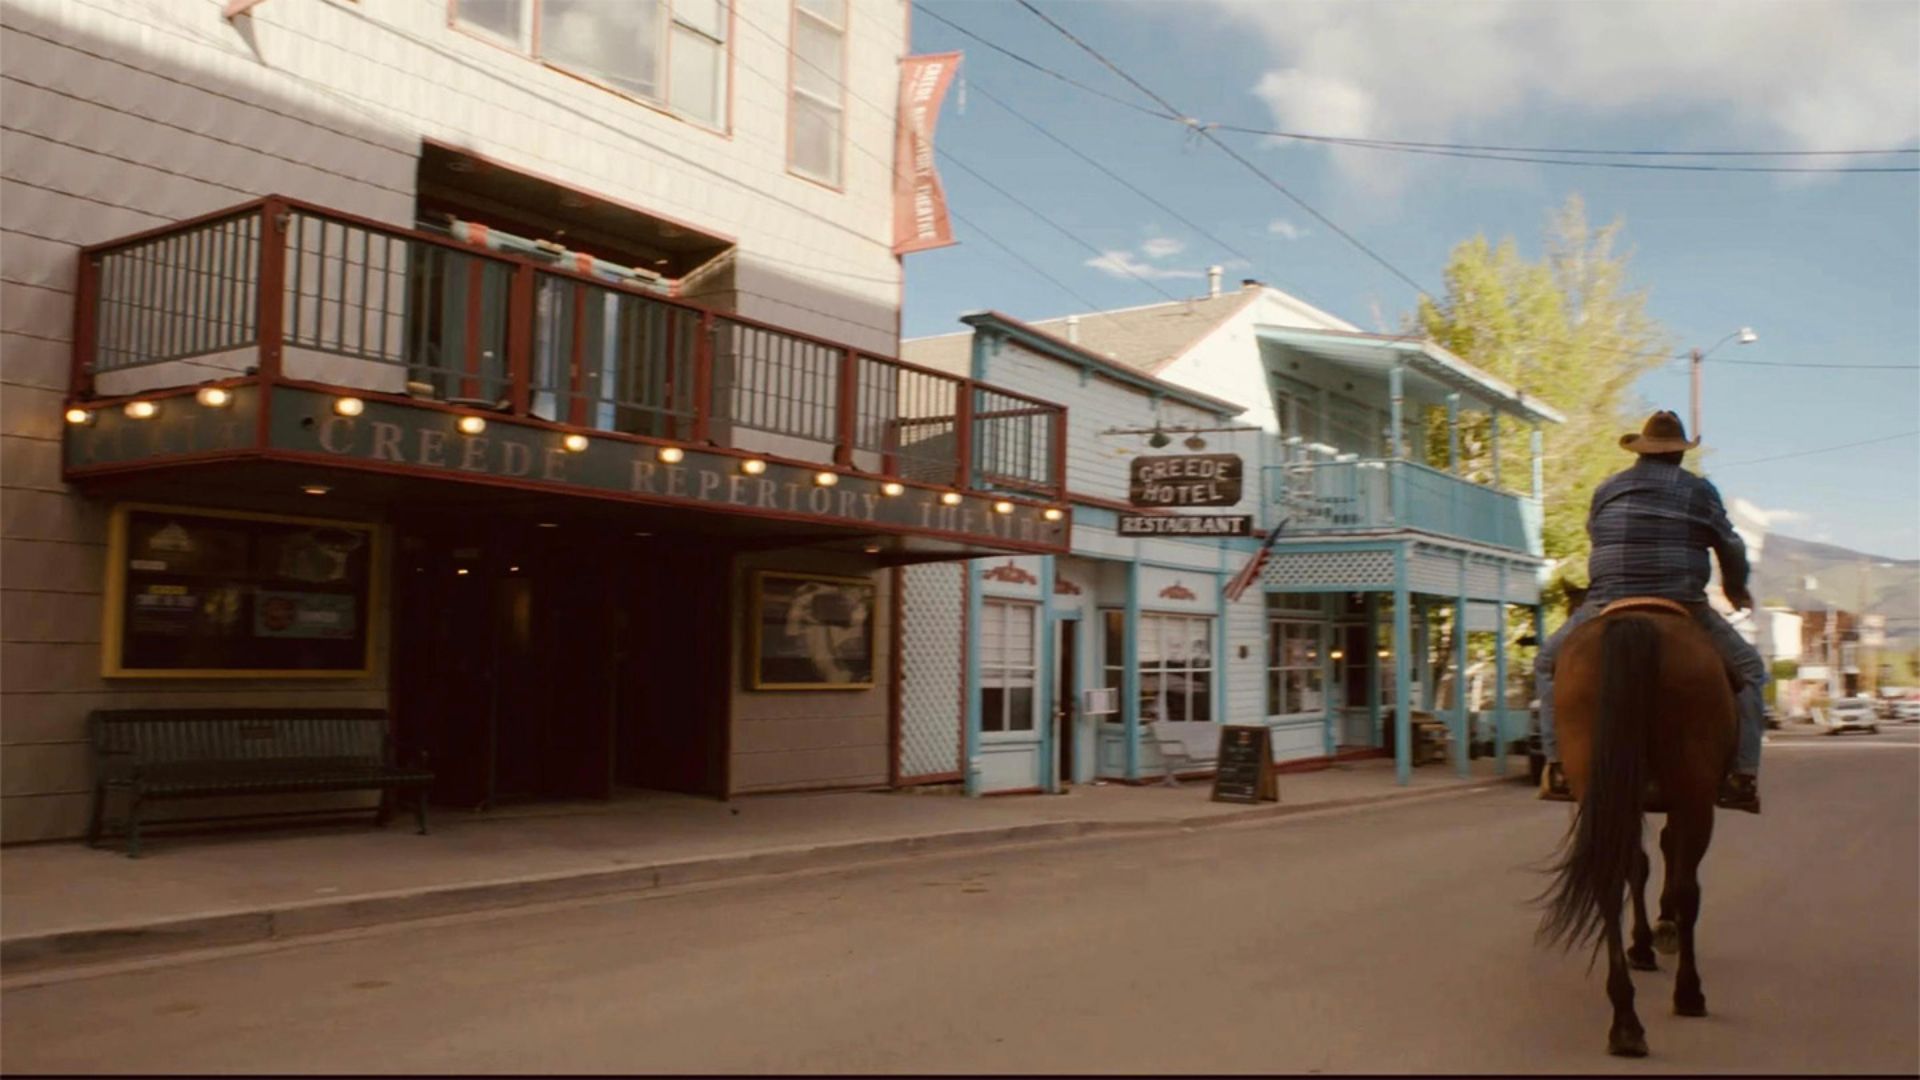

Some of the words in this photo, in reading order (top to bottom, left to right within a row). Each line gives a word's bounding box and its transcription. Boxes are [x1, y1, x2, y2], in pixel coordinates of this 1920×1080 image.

[318, 418, 567, 482] CREEDE
[629, 460, 879, 521] REPERTORY
[920, 502, 1060, 543] THEATRE
[1139, 458, 1231, 482] CREEDE
[1142, 482, 1224, 504] HOTEL
[1122, 517, 1242, 533] RESTAURANT
